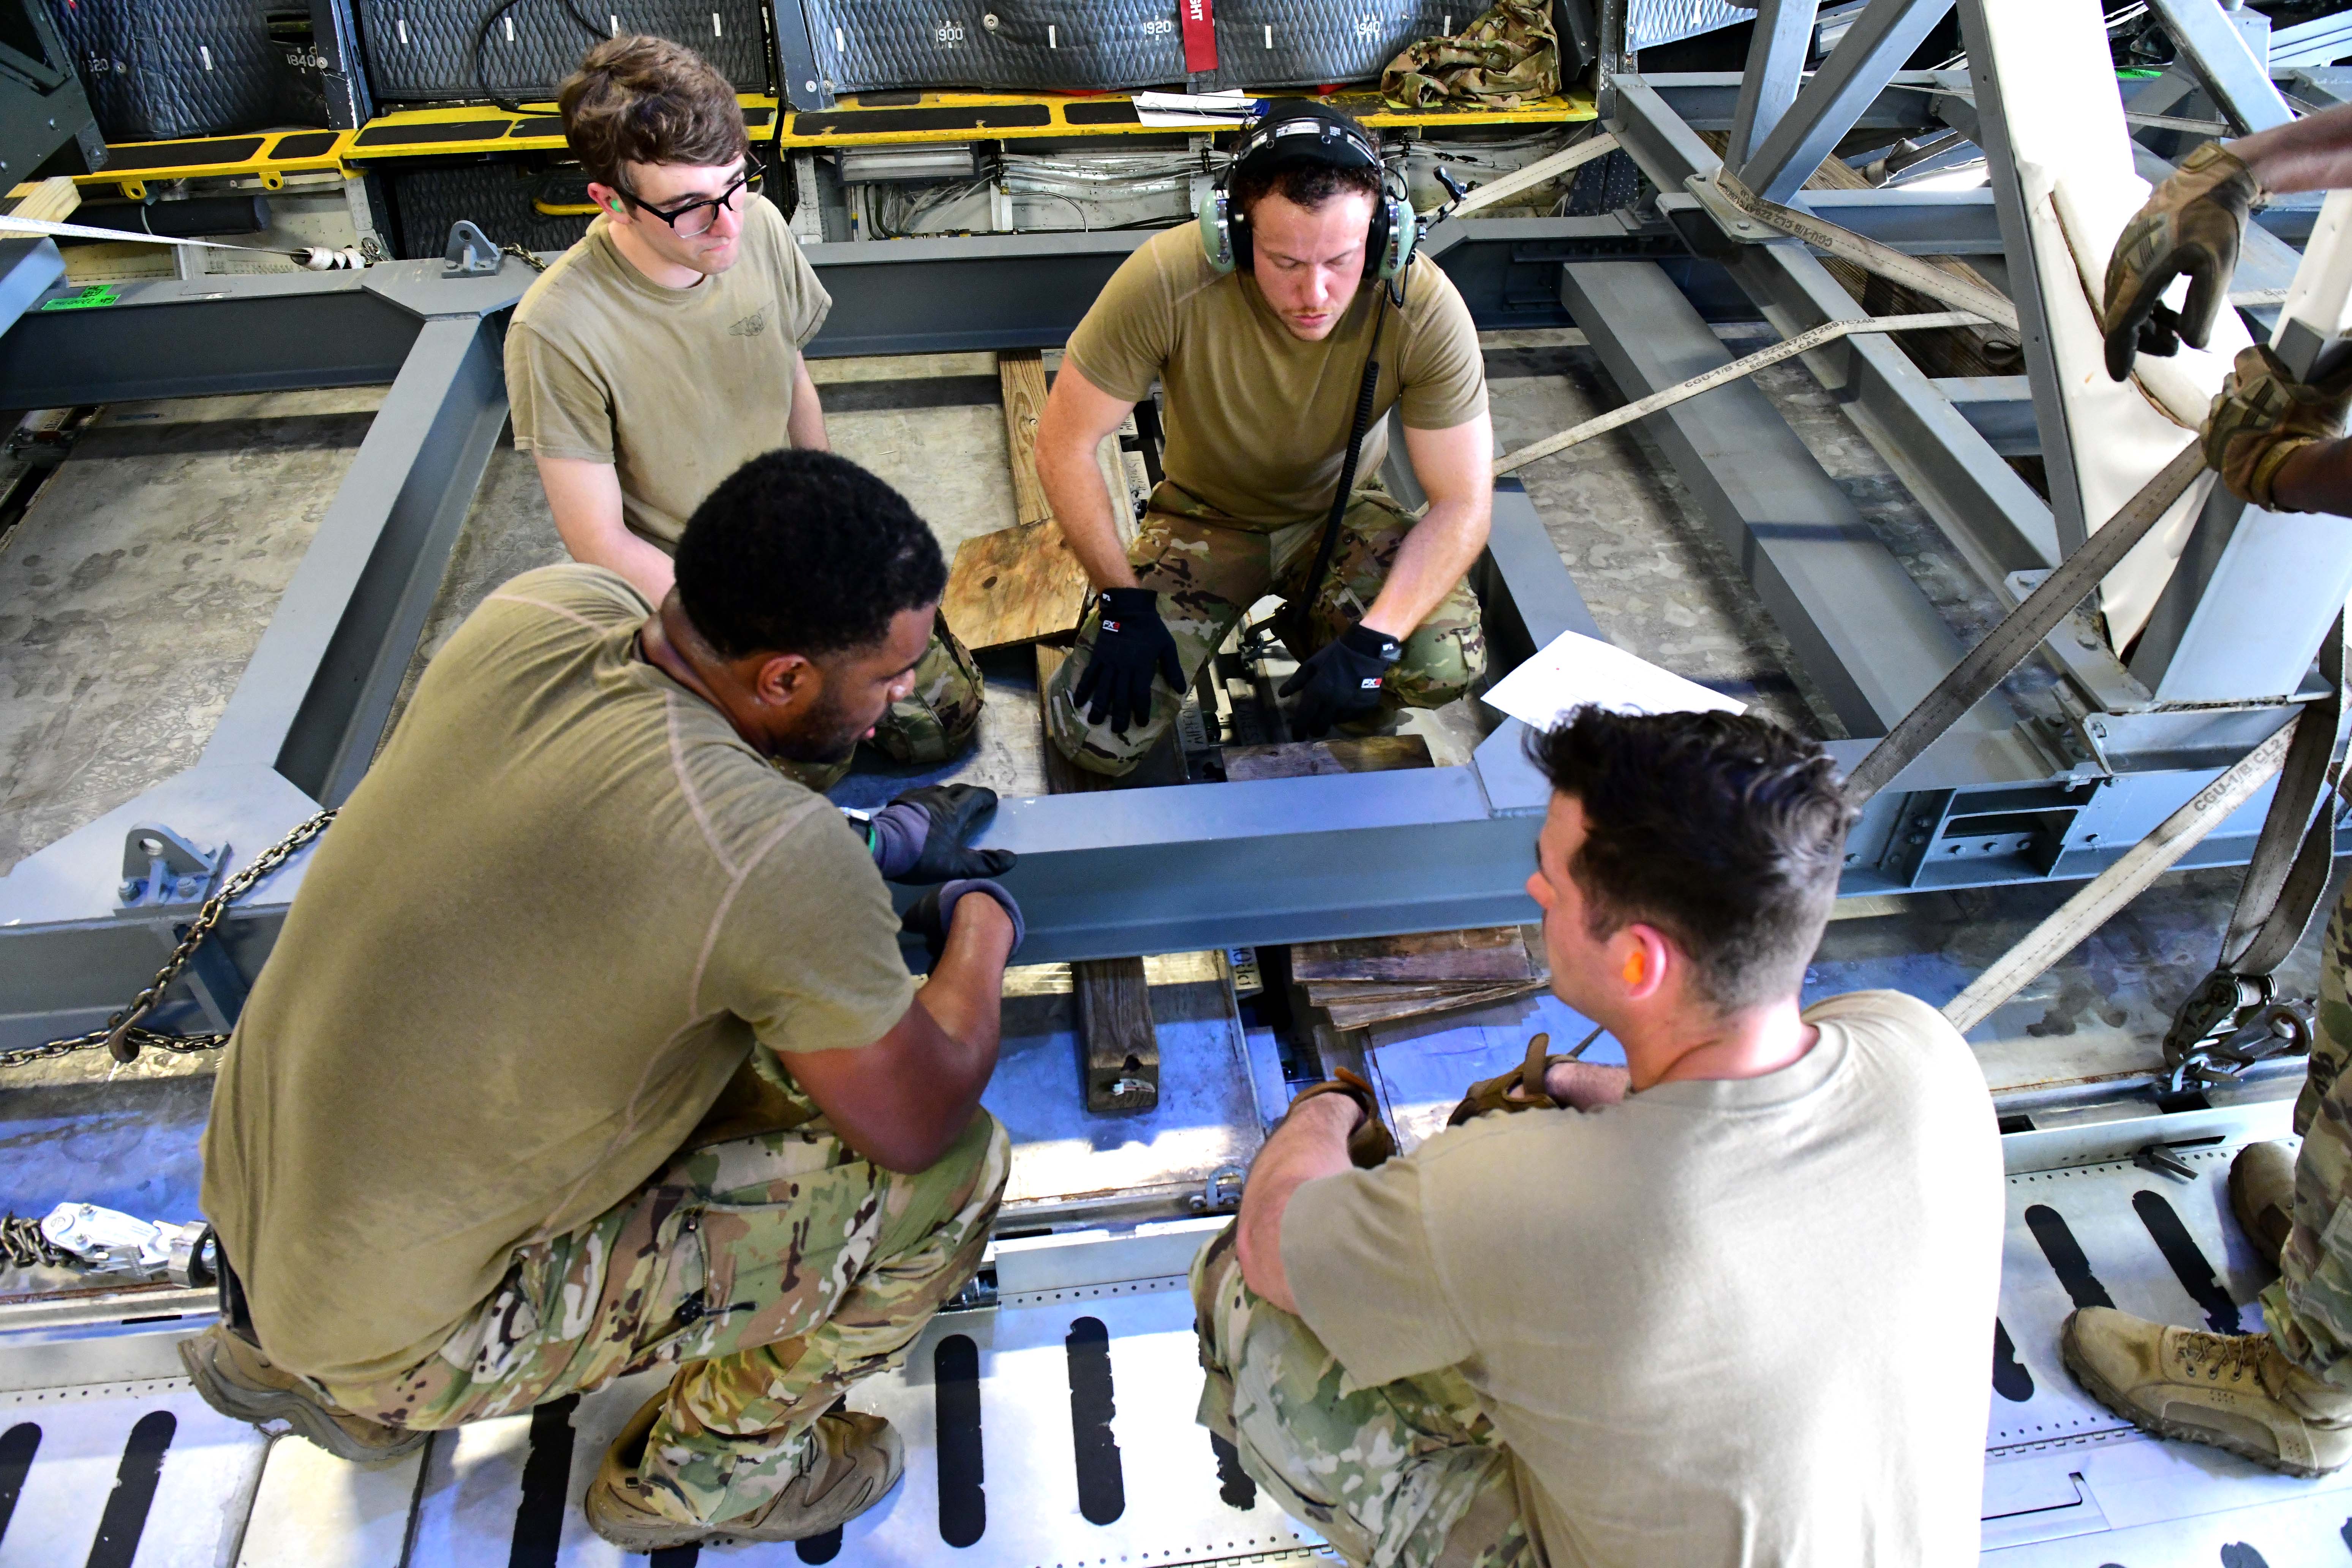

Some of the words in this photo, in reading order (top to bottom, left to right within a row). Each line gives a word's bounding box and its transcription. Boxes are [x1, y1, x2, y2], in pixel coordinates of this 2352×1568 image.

[1143, 21, 1171, 35] 1920
[1356, 21, 1380, 35] 1940
[935, 28, 963, 43] 1900
[286, 54, 316, 67] 1840
[1685, 366, 1733, 387] CGU-1/B
[1103, 620, 1120, 630] FX3
[2194, 763, 2252, 811] CGU-1/B
